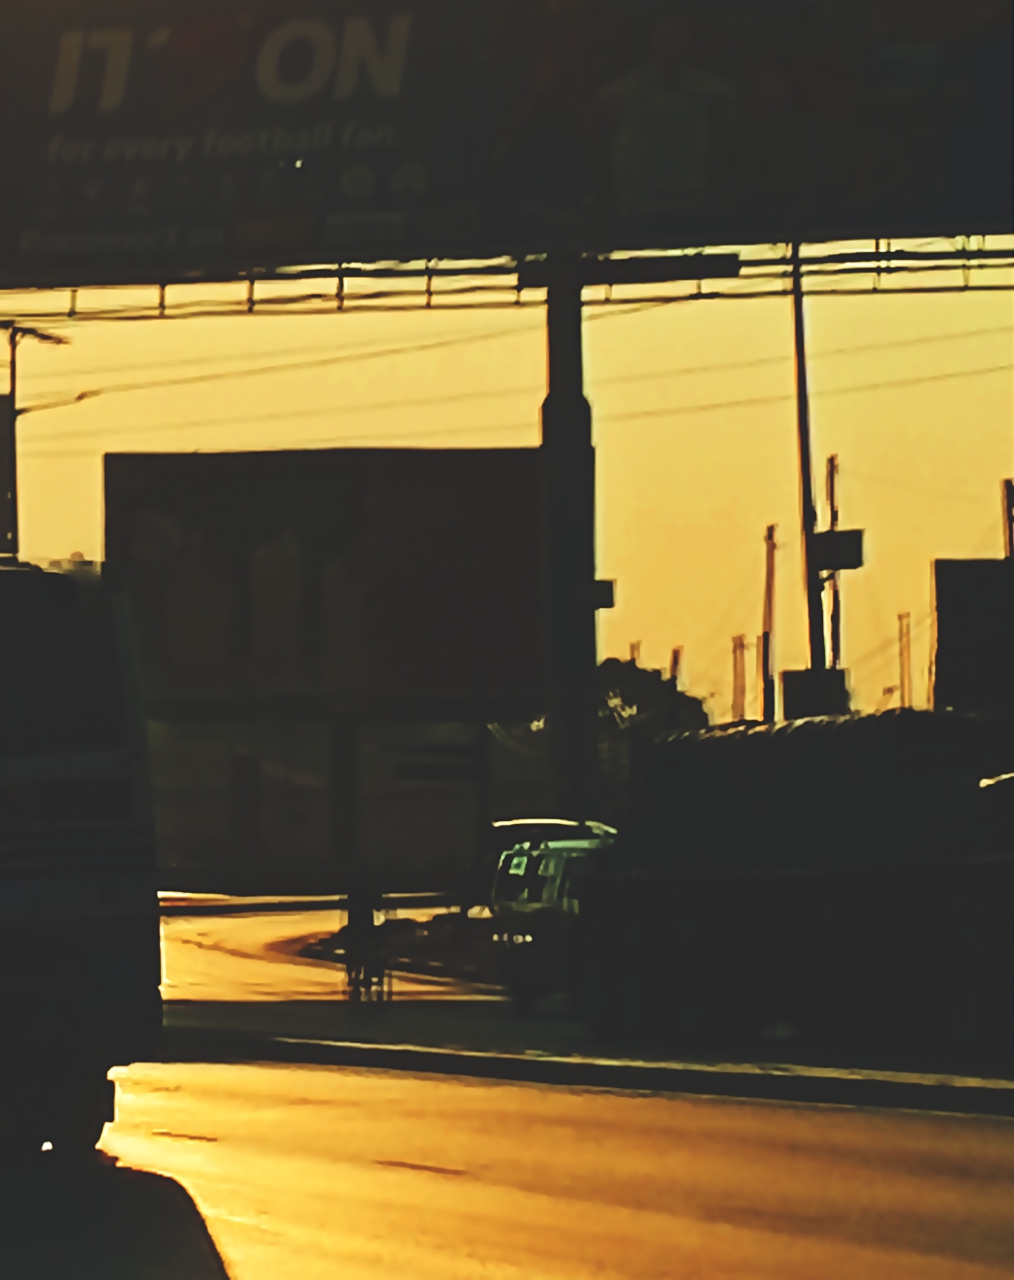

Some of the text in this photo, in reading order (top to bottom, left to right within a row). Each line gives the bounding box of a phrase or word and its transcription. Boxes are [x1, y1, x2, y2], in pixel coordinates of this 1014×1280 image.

[255, 13, 413, 104] ON
[45, 132, 98, 164] for
[102, 133, 195, 166] every
[201, 121, 334, 157] football
